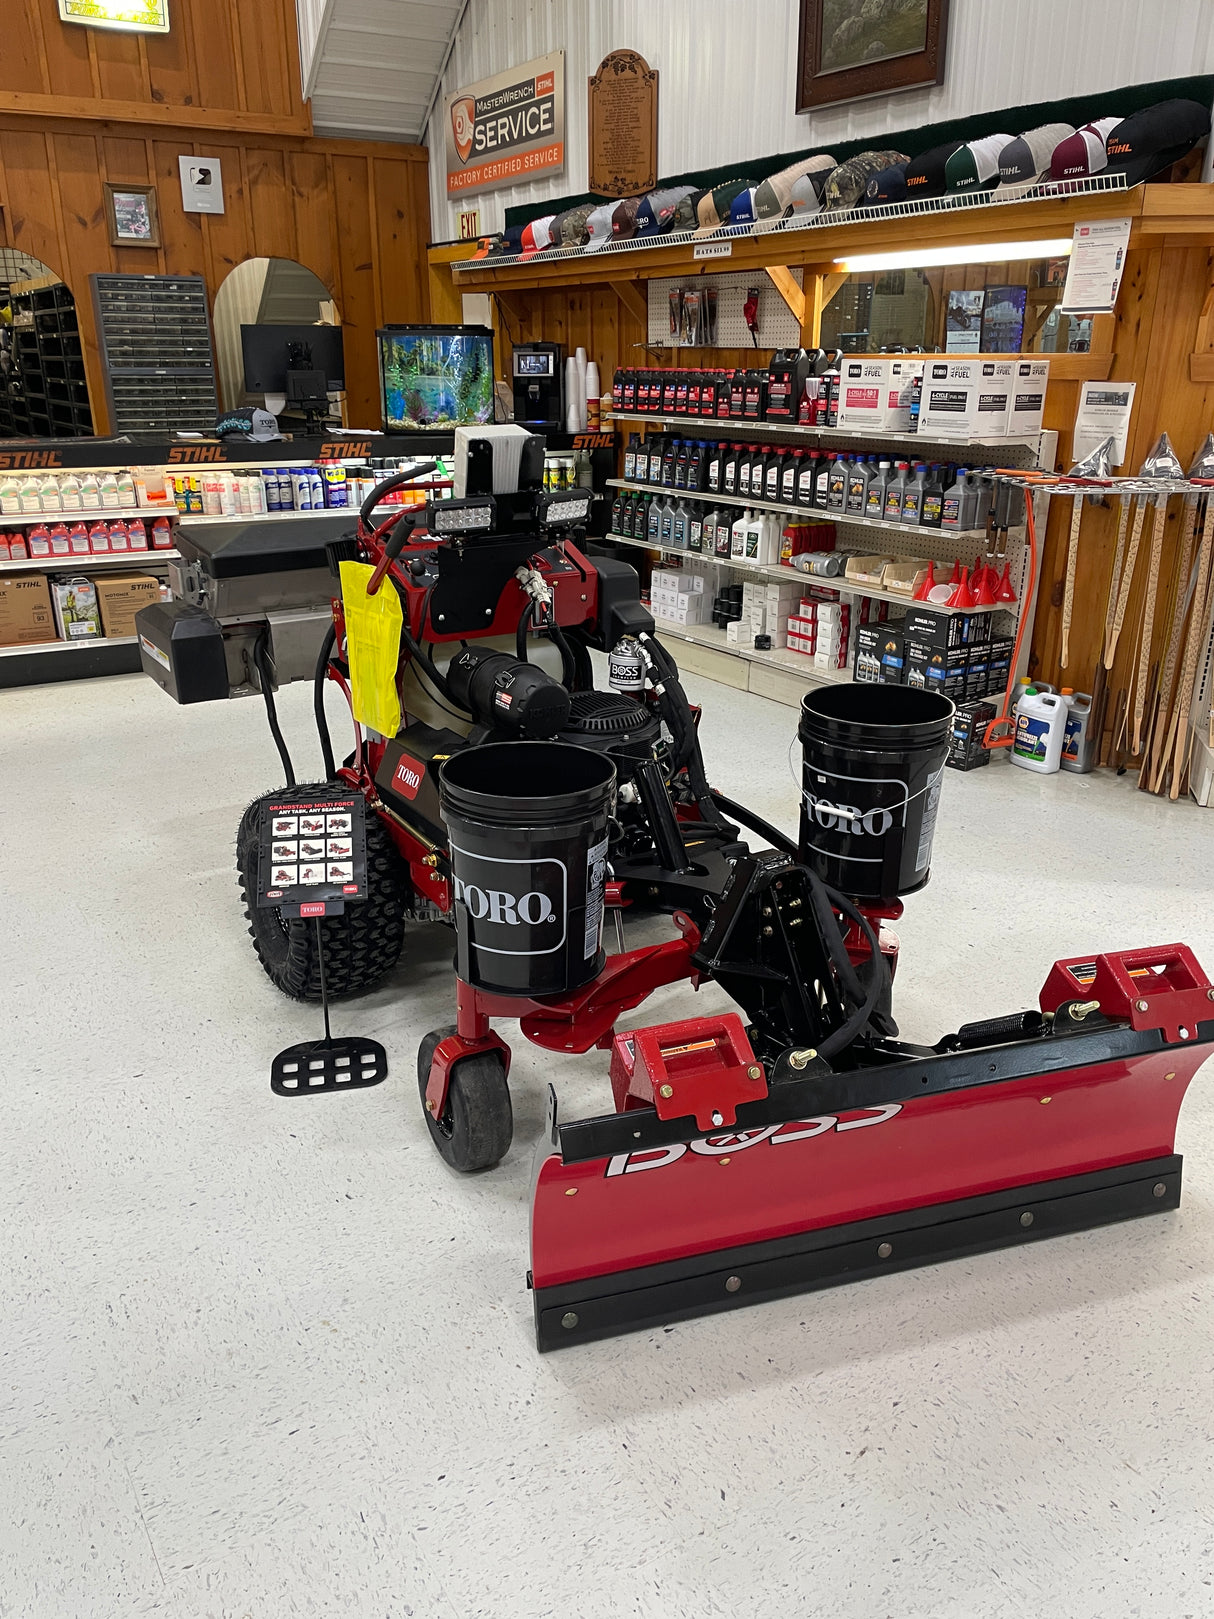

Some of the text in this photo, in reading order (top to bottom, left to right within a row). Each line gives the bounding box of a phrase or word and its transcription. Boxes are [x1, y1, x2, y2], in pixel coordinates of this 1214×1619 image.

[537, 78, 553, 91] STIHL
[475, 102, 552, 151] SERVICE
[1107, 144, 1132, 154] STIHL
[450, 148, 558, 188] FACTORY CERTIFIED SERVICE
[1000, 166, 1021, 175] STIHL
[1063, 166, 1085, 175] STIHL
[907, 176, 928, 187] STIHL
[956, 177, 975, 187] STIHL
[460, 212, 477, 240] EXIT
[572, 435, 613, 449] STIHL
[168, 446, 227, 463] STIHL
[319, 442, 371, 458] STIHL
[0, 450, 62, 468] STIHL
[16, 581, 42, 589] STIHL
[131, 582, 155, 591] STIHL
[612, 664, 639, 676] BOSS
[397, 764, 420, 789] TORO
[804, 790, 893, 837] TORO
[451, 874, 553, 926] TORO
